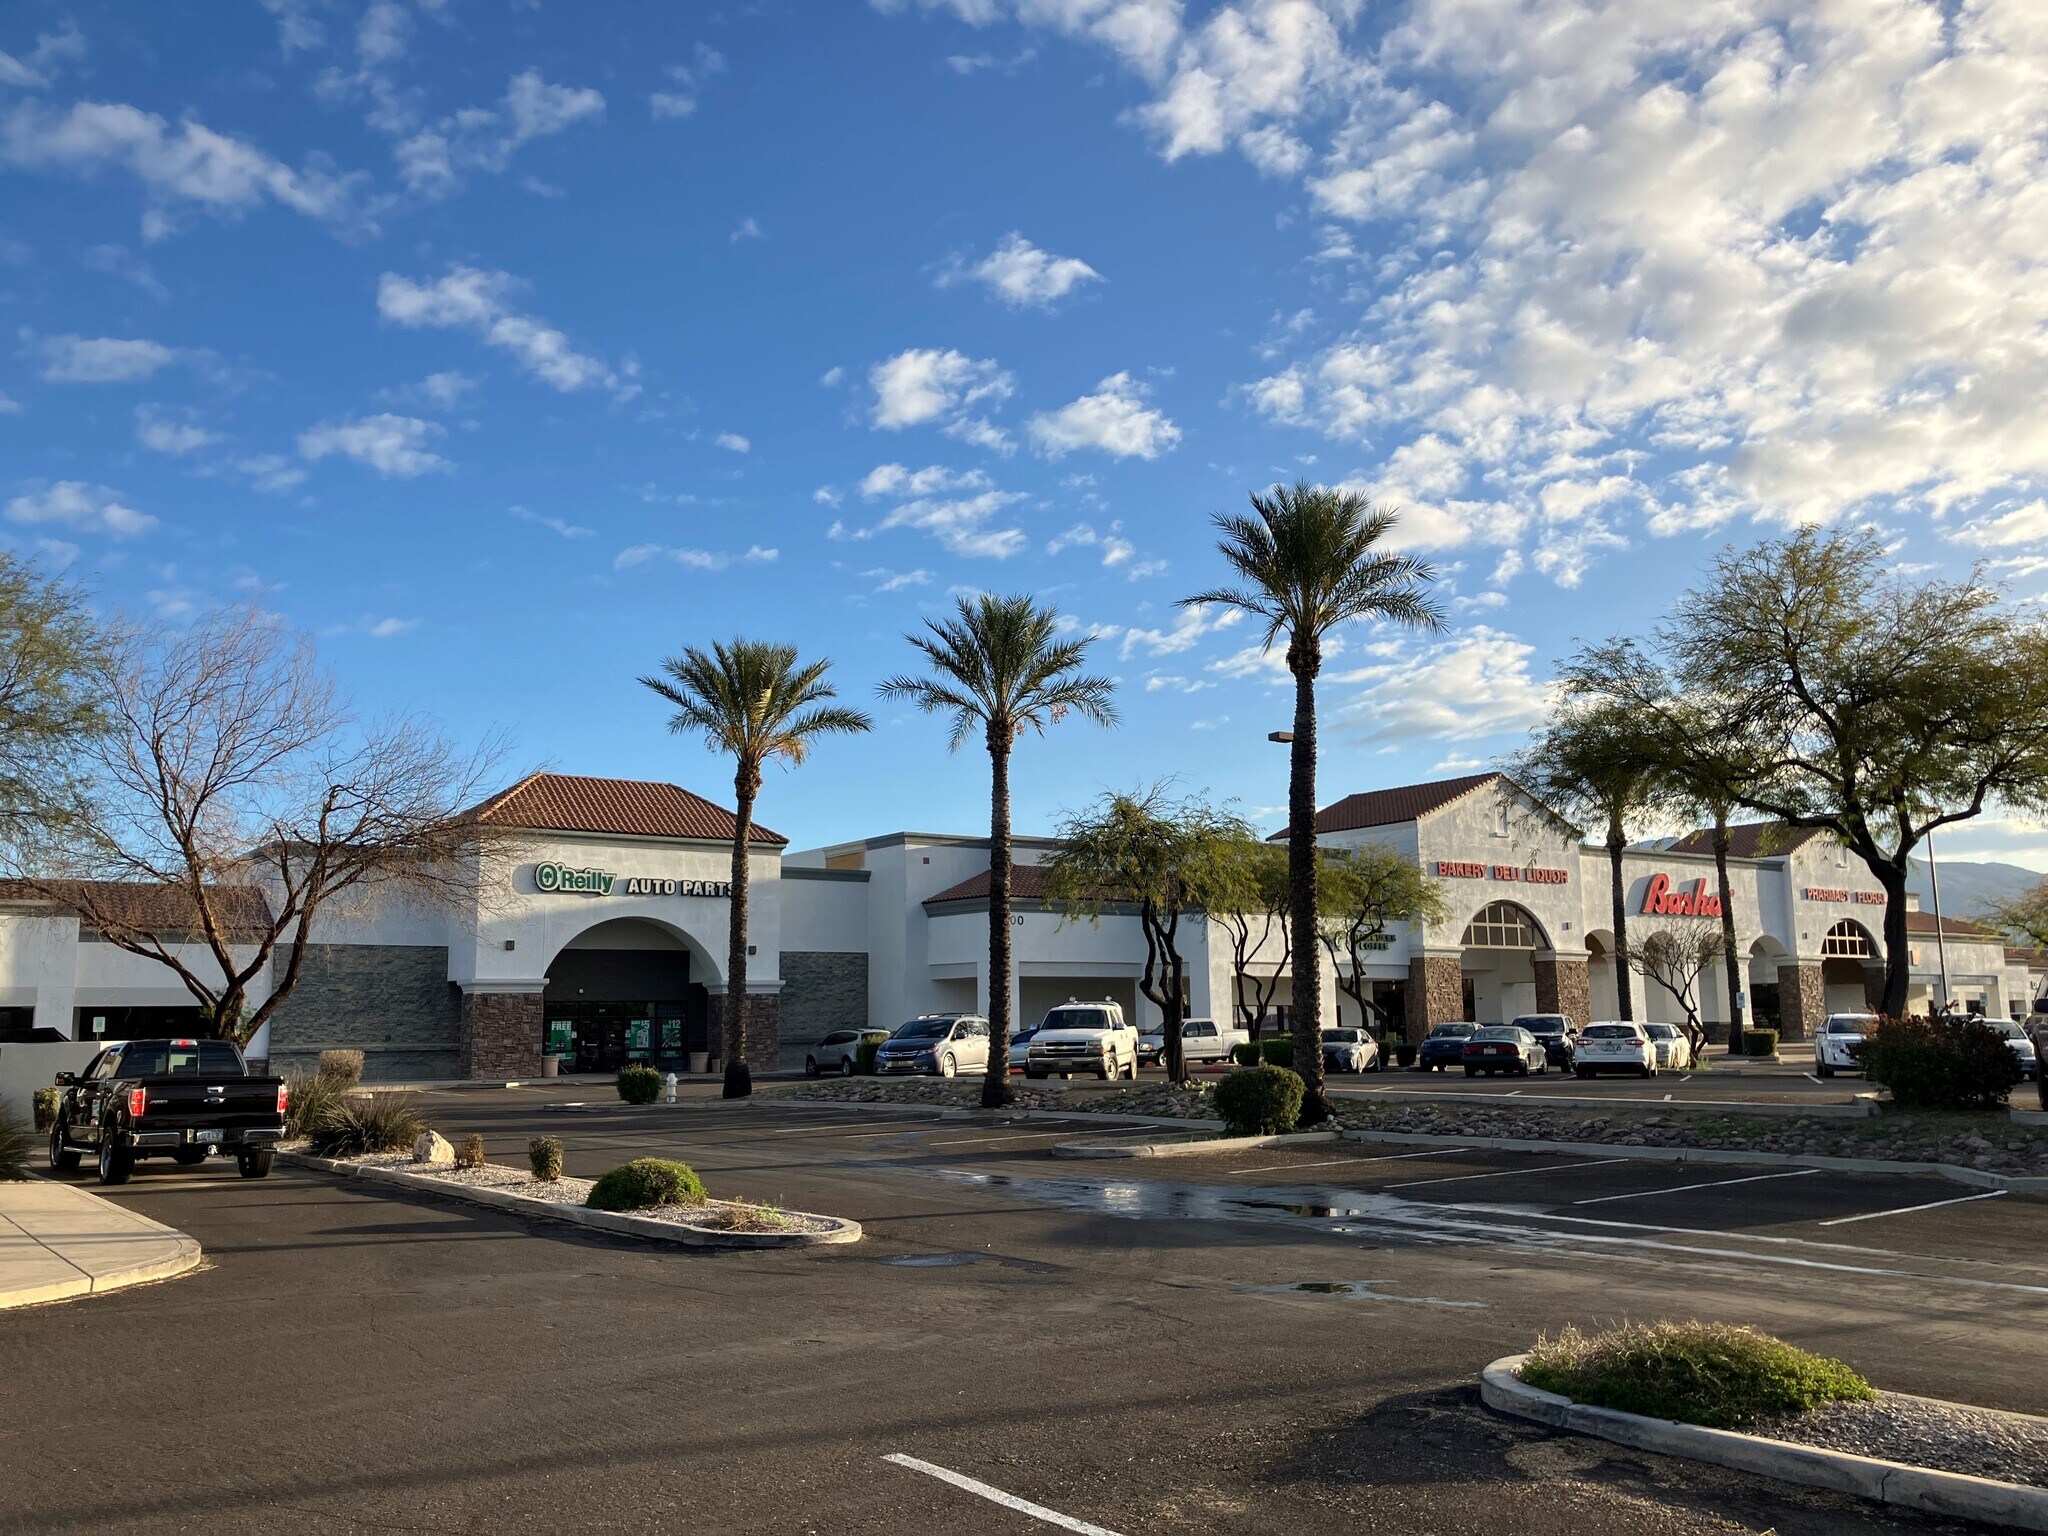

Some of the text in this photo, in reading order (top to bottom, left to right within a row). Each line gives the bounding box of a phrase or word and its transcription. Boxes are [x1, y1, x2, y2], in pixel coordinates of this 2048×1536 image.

[538, 864, 614, 894] O'Reilly
[627, 878, 676, 895] AUTO
[1438, 861, 1568, 884] BAKERY DELI LIQUOR
[1641, 872, 1735, 917] Basha'
[1010, 915, 1024, 925] 00
[552, 1023, 571, 1031] FREE
